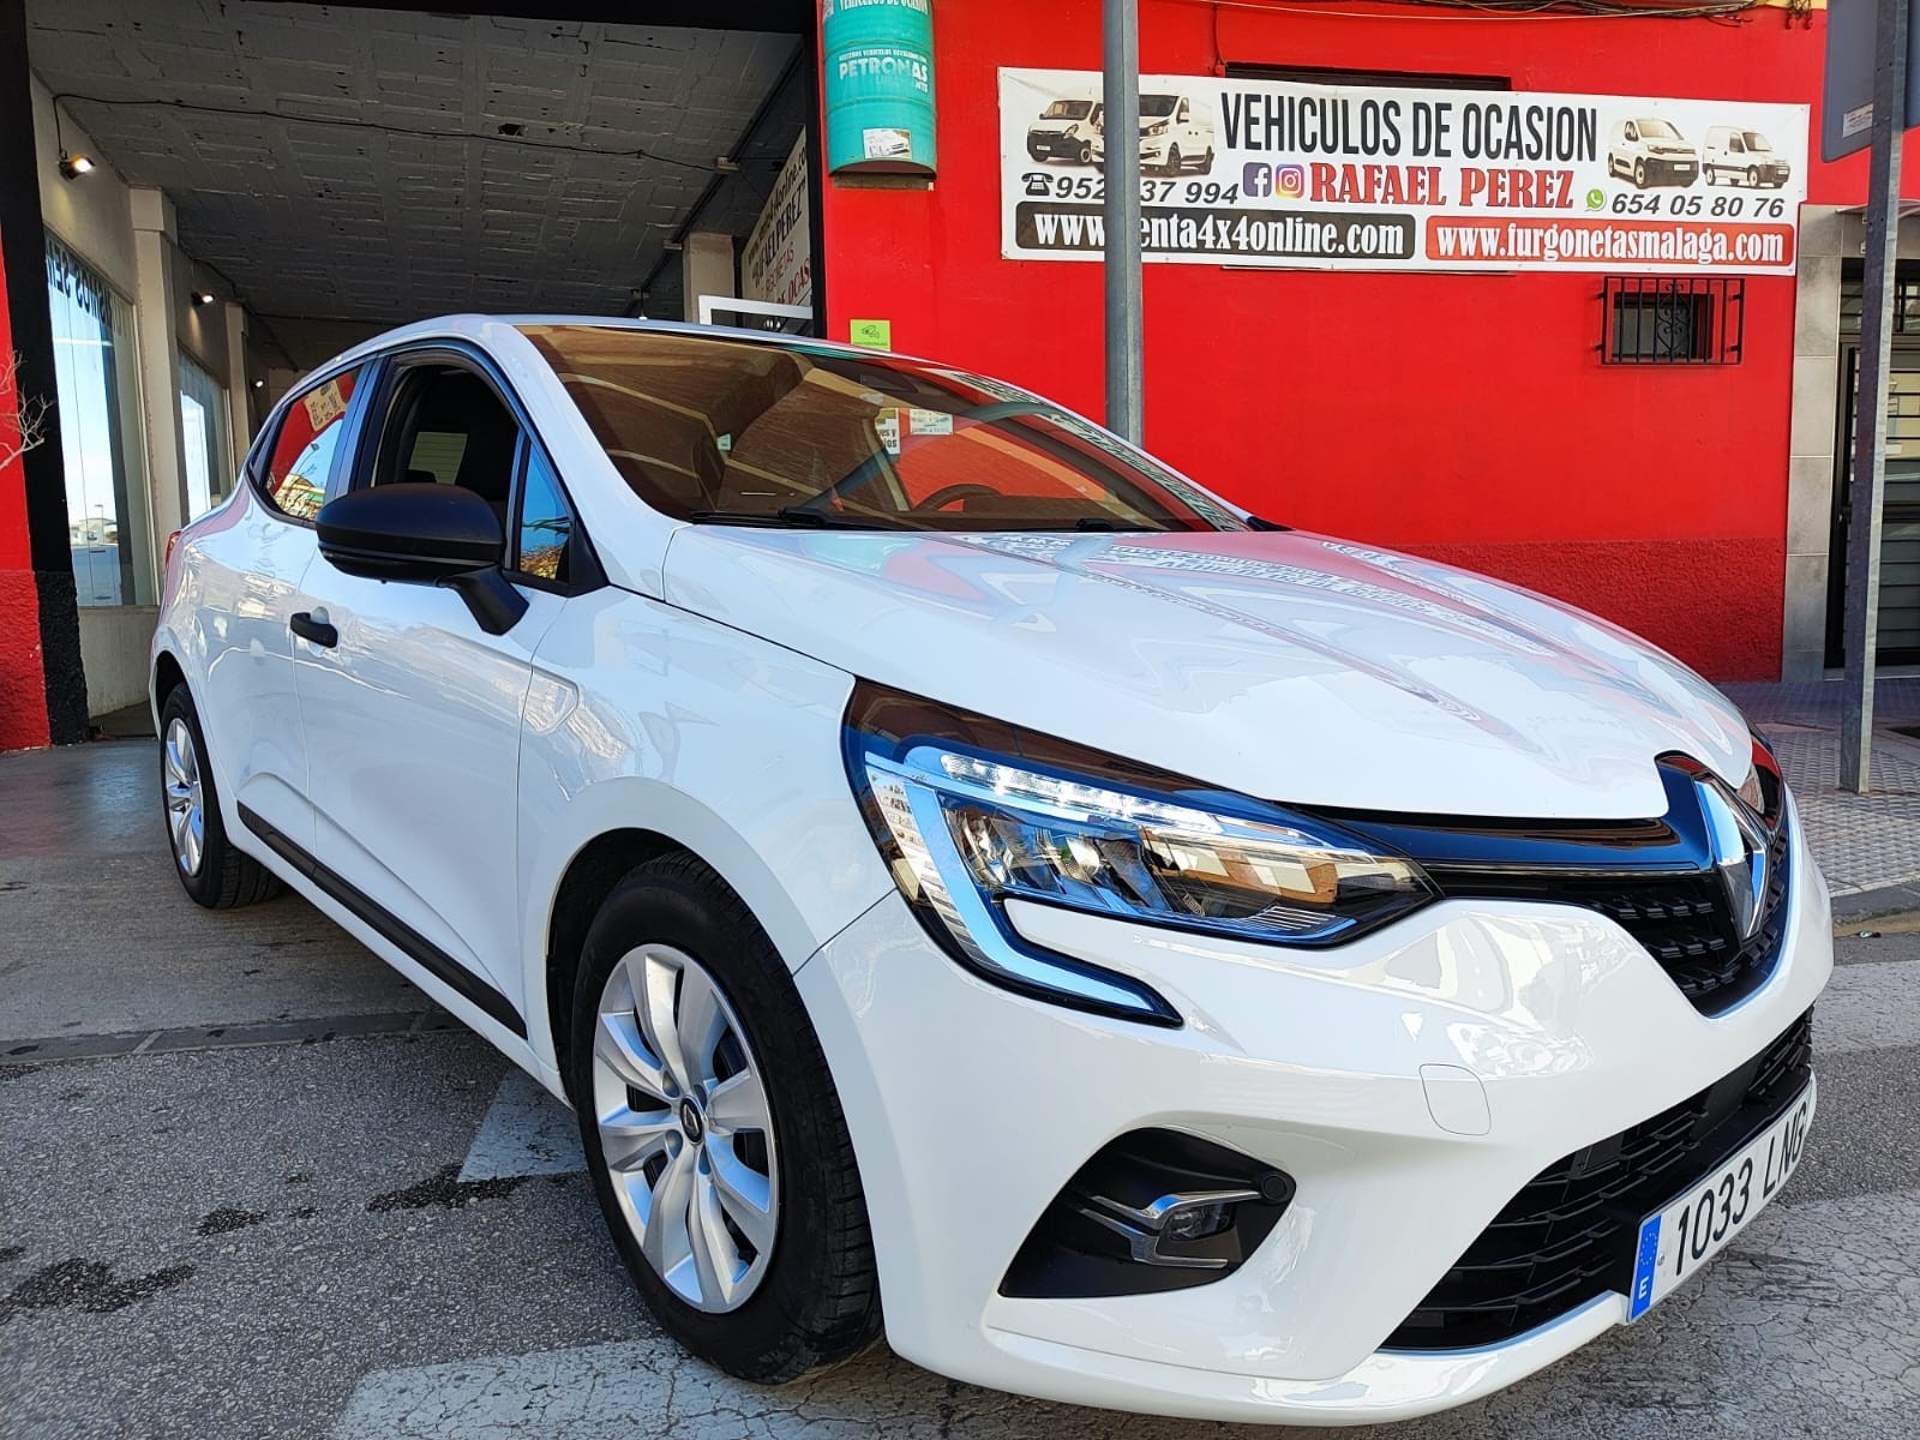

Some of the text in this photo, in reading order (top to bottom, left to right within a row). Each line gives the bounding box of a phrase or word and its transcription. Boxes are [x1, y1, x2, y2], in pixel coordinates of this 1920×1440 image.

[839, 56, 928, 82] PETRONAS
[1221, 92, 1597, 161] VEHICULOS DE OCASION
[1140, 180, 1177, 202] 37
[1185, 182, 1239, 204] 994
[1310, 163, 1574, 209] RAFAEL PEREZ
[1611, 193, 1785, 218] 654 05 80 76
[1033, 212, 1404, 255] wwwenta4x4online.com
[1437, 221, 1784, 264] www.furgonetasmalaga.com
[1675, 1100, 1807, 1277] 1033 LNG
[1638, 1276, 1649, 1299] E
